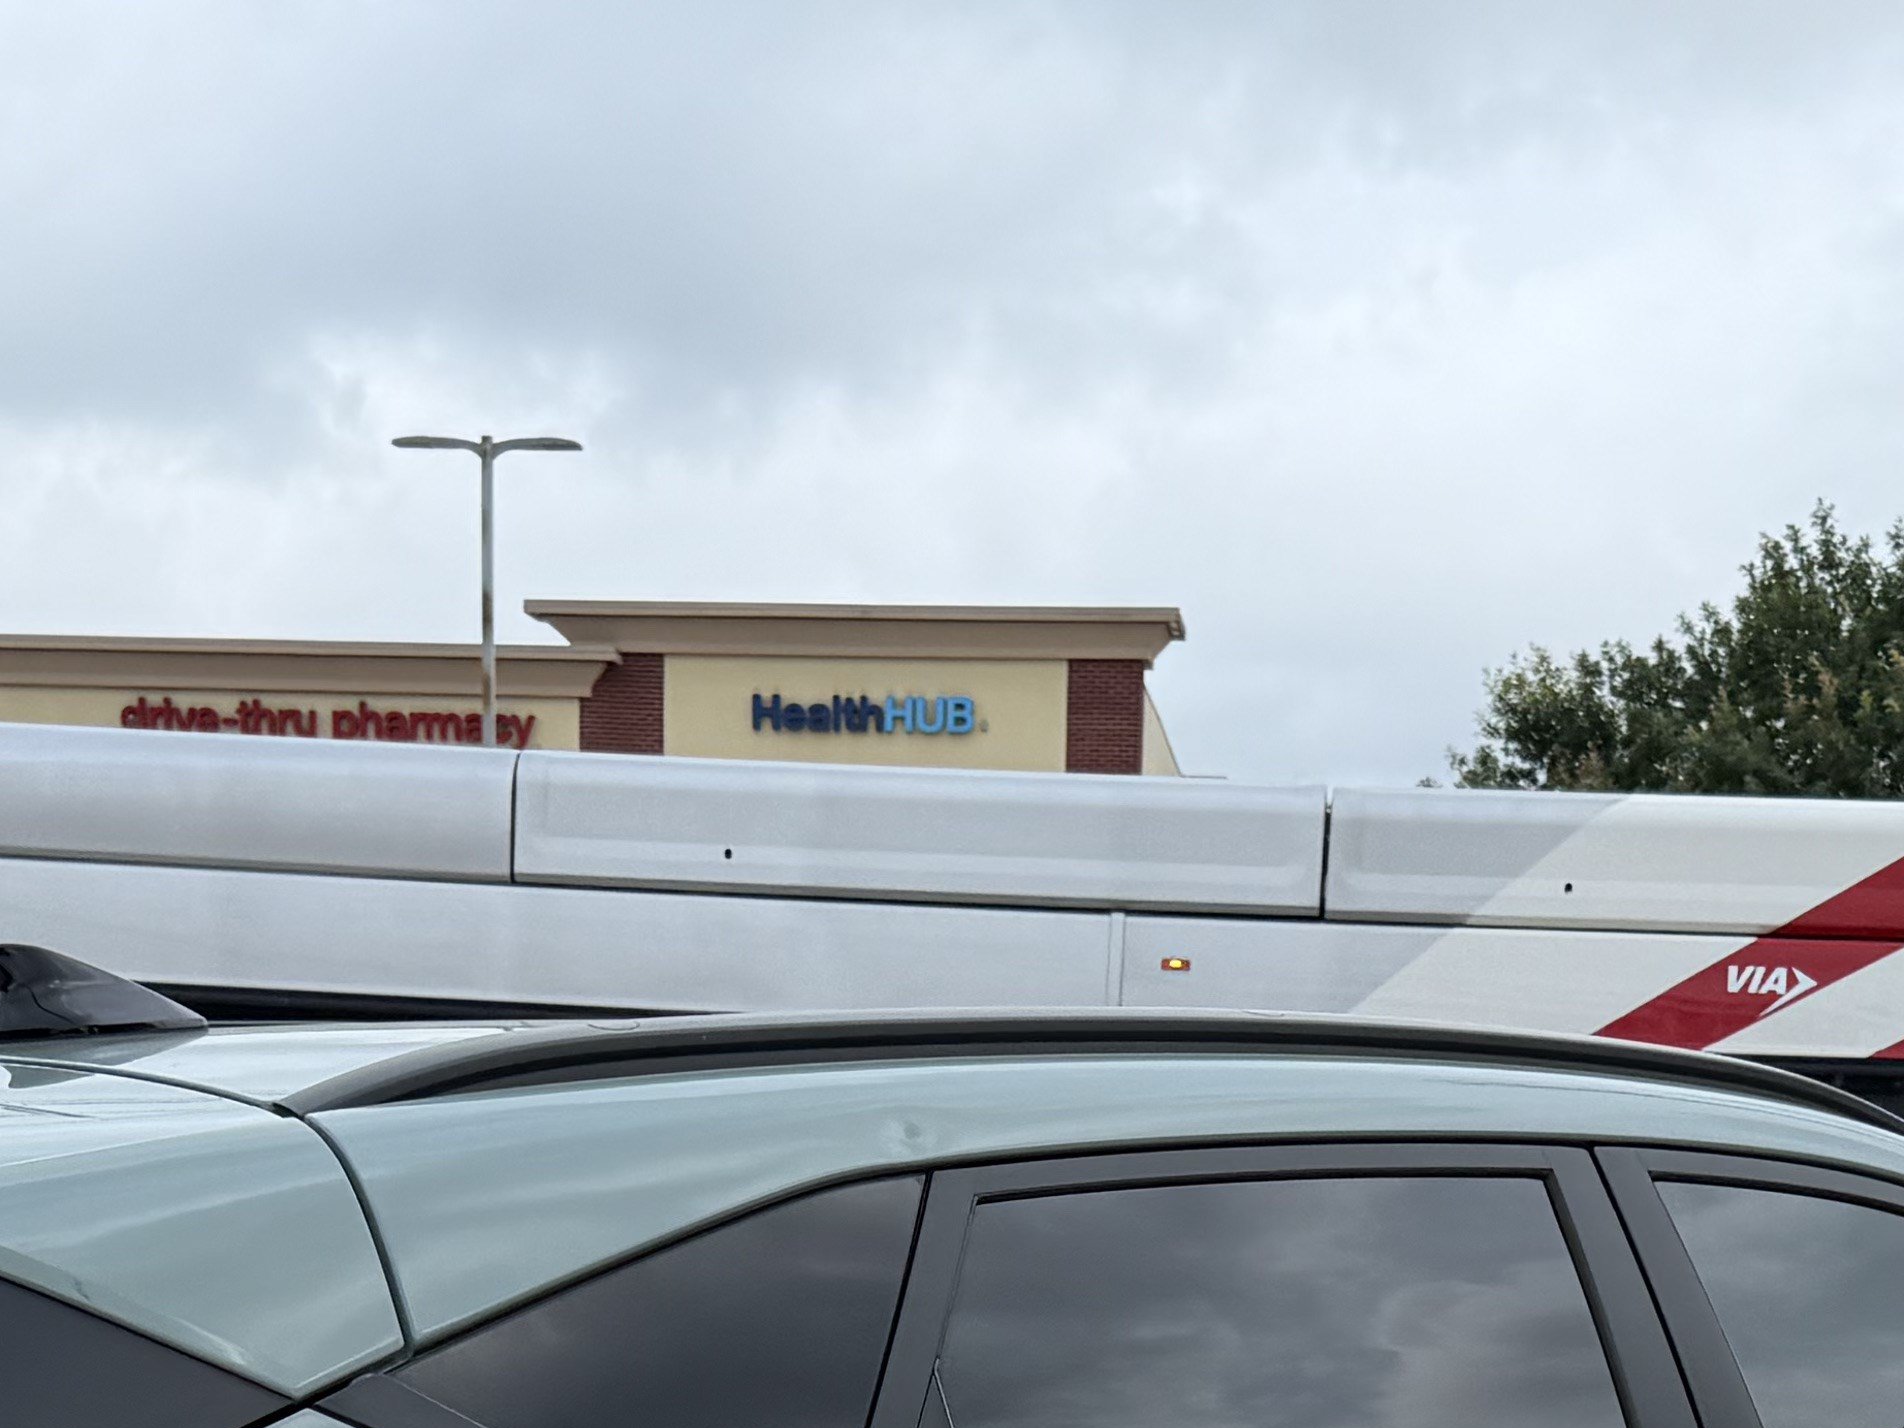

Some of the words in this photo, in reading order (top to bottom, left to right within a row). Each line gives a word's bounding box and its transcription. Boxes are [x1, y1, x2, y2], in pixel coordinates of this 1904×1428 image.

[121, 697, 317, 738] drive-thru
[332, 701, 537, 748] pharmacy
[752, 694, 976, 733] HealthHUB
[1726, 965, 1788, 995] VIA
